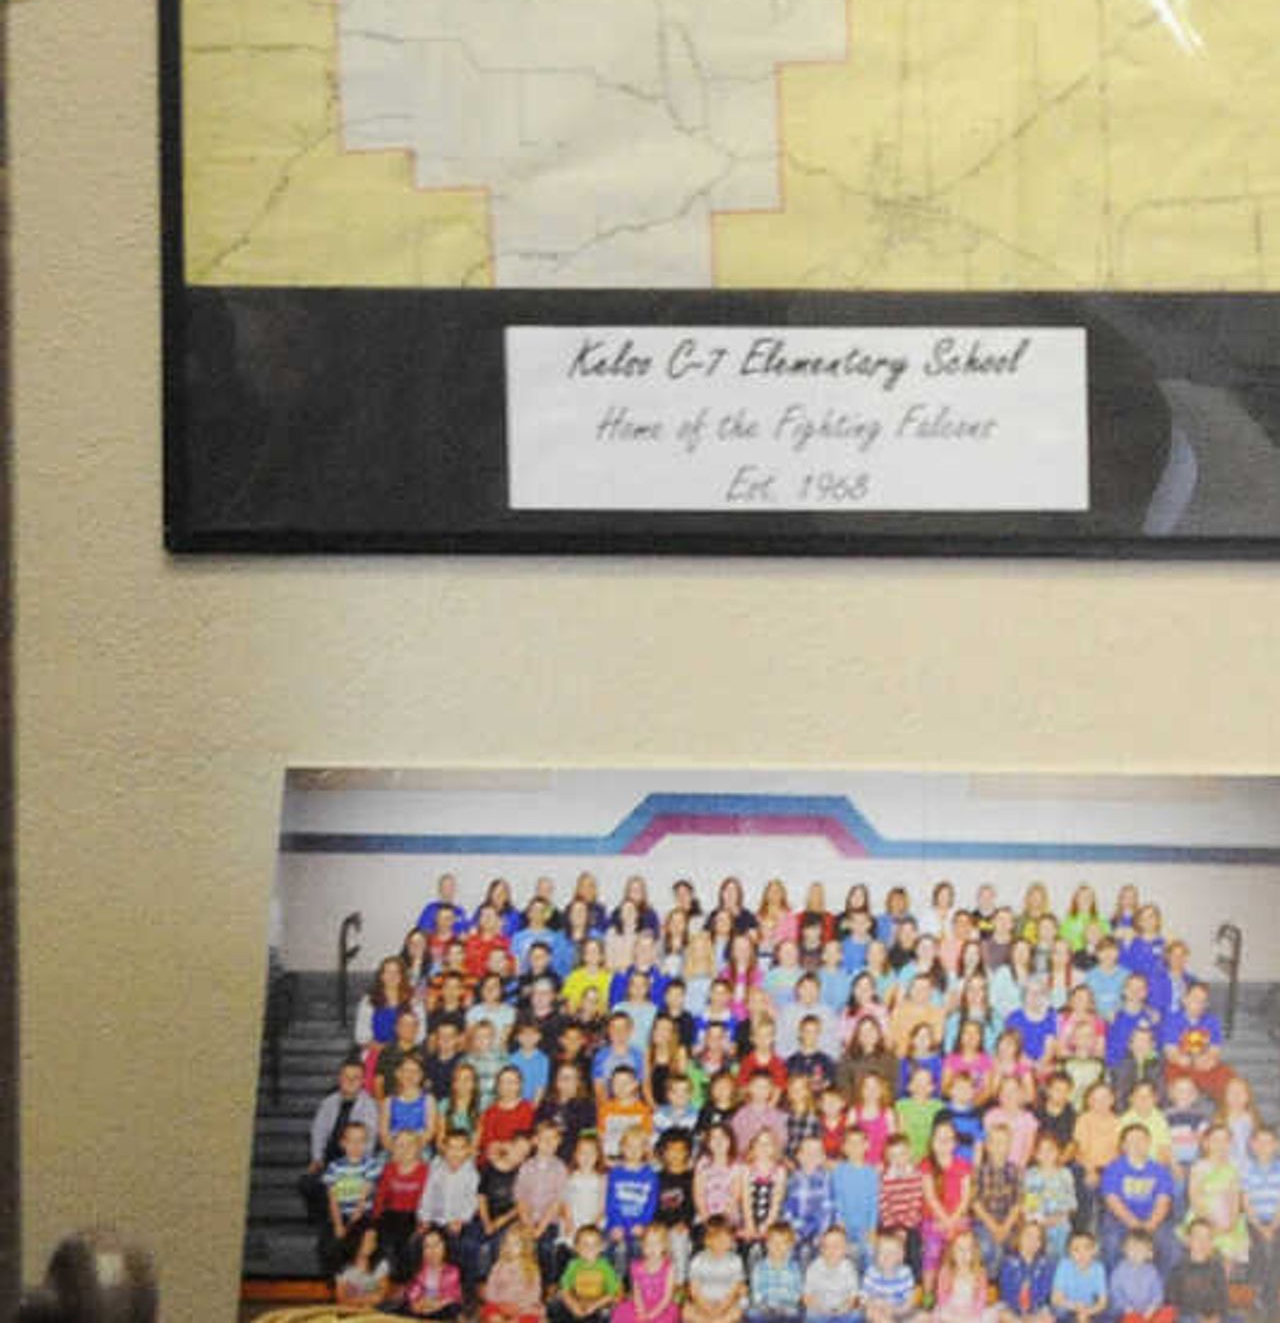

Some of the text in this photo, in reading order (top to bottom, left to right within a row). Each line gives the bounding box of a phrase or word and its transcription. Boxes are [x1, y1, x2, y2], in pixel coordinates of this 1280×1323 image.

[667, 337, 728, 379] C-7
[740, 336, 909, 392] Elementary
[924, 336, 1031, 376] School
[595, 402, 998, 453] Home of the Fighting Falcons
